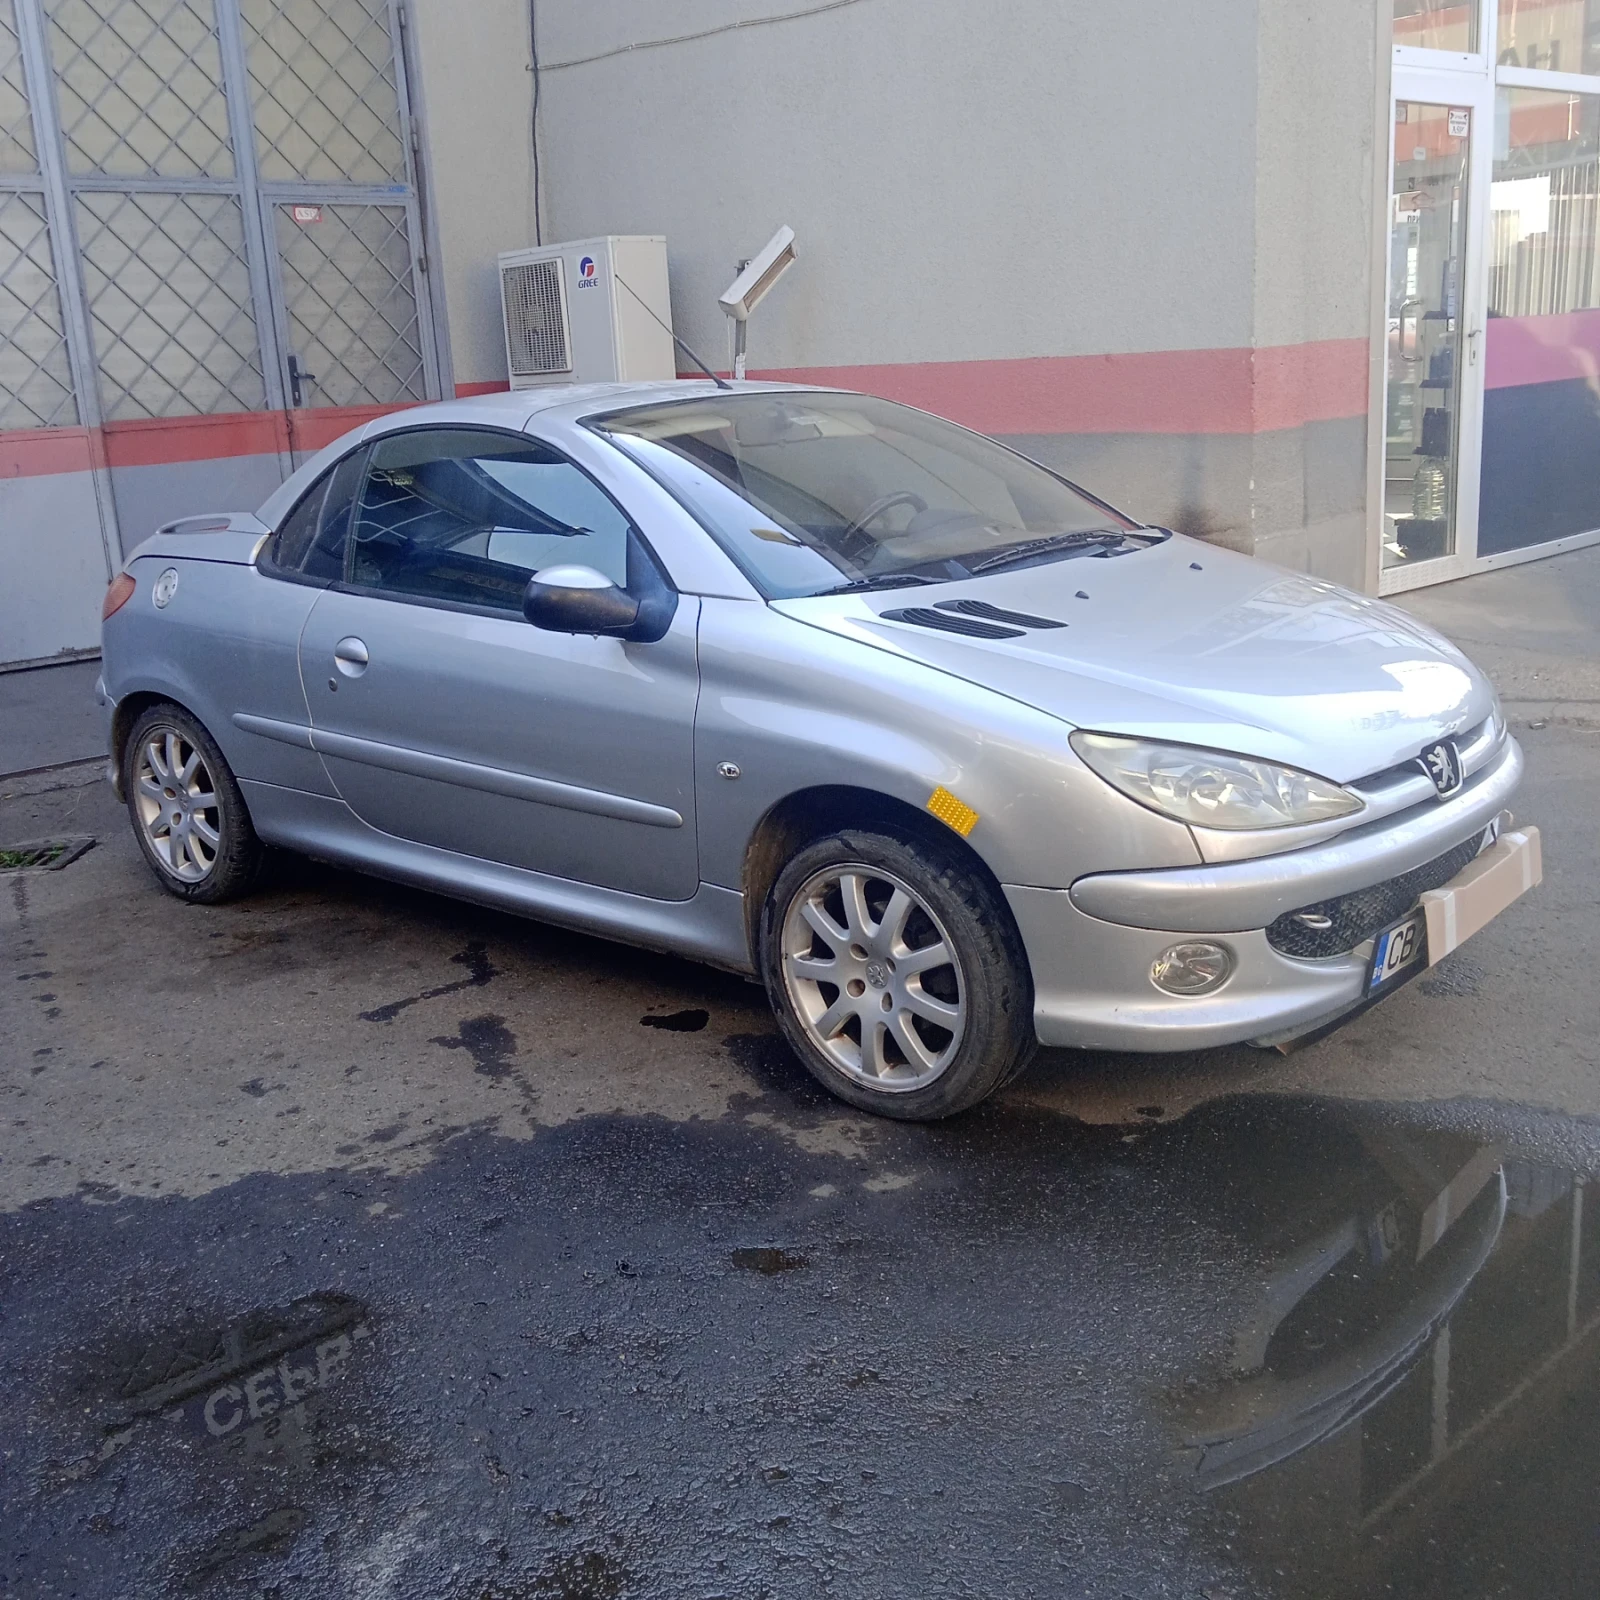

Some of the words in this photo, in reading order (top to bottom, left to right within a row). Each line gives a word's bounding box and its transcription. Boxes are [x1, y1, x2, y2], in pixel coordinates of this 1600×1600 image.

[578, 277, 598, 288] GREE
[1388, 924, 1416, 970] CB
[1372, 965, 1383, 979] BG
